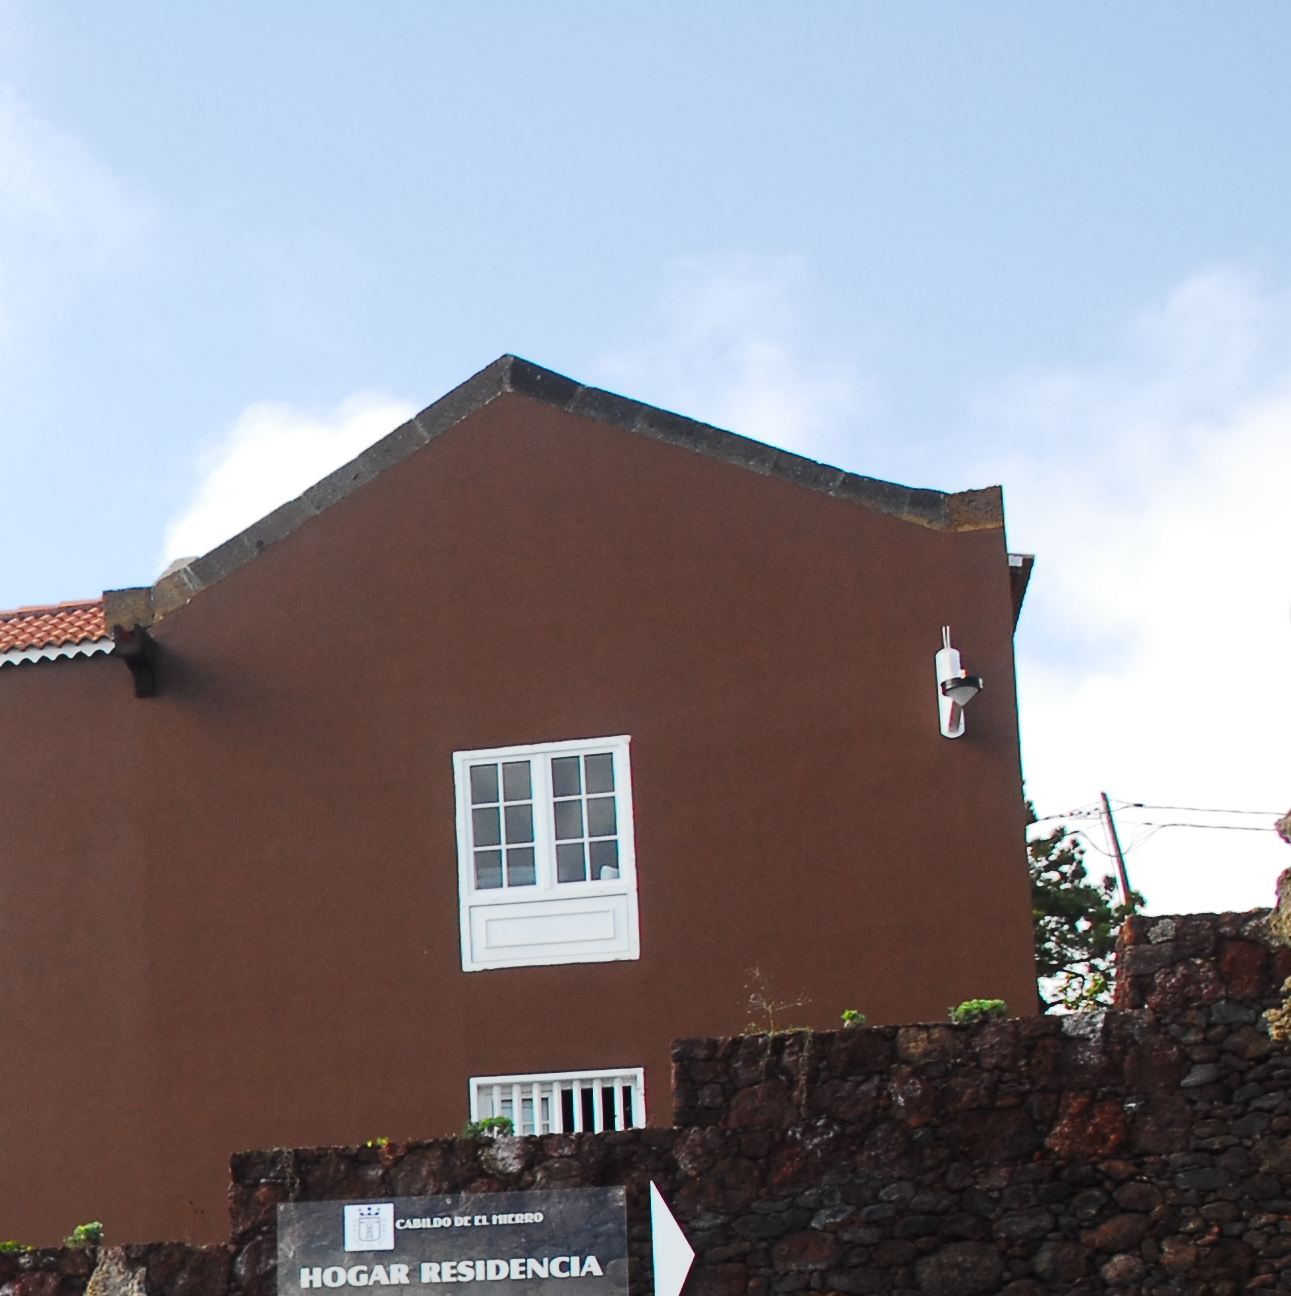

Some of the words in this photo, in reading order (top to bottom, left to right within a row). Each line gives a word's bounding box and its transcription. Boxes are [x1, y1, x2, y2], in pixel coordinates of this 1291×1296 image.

[395, 1217, 452, 1230] CABILDO
[454, 1216, 472, 1227] DE
[473, 1214, 490, 1226] EL
[491, 1212, 544, 1225] HIERRO
[299, 1263, 410, 1289] HOGAR
[420, 1255, 604, 1284] RESIDENCIA
